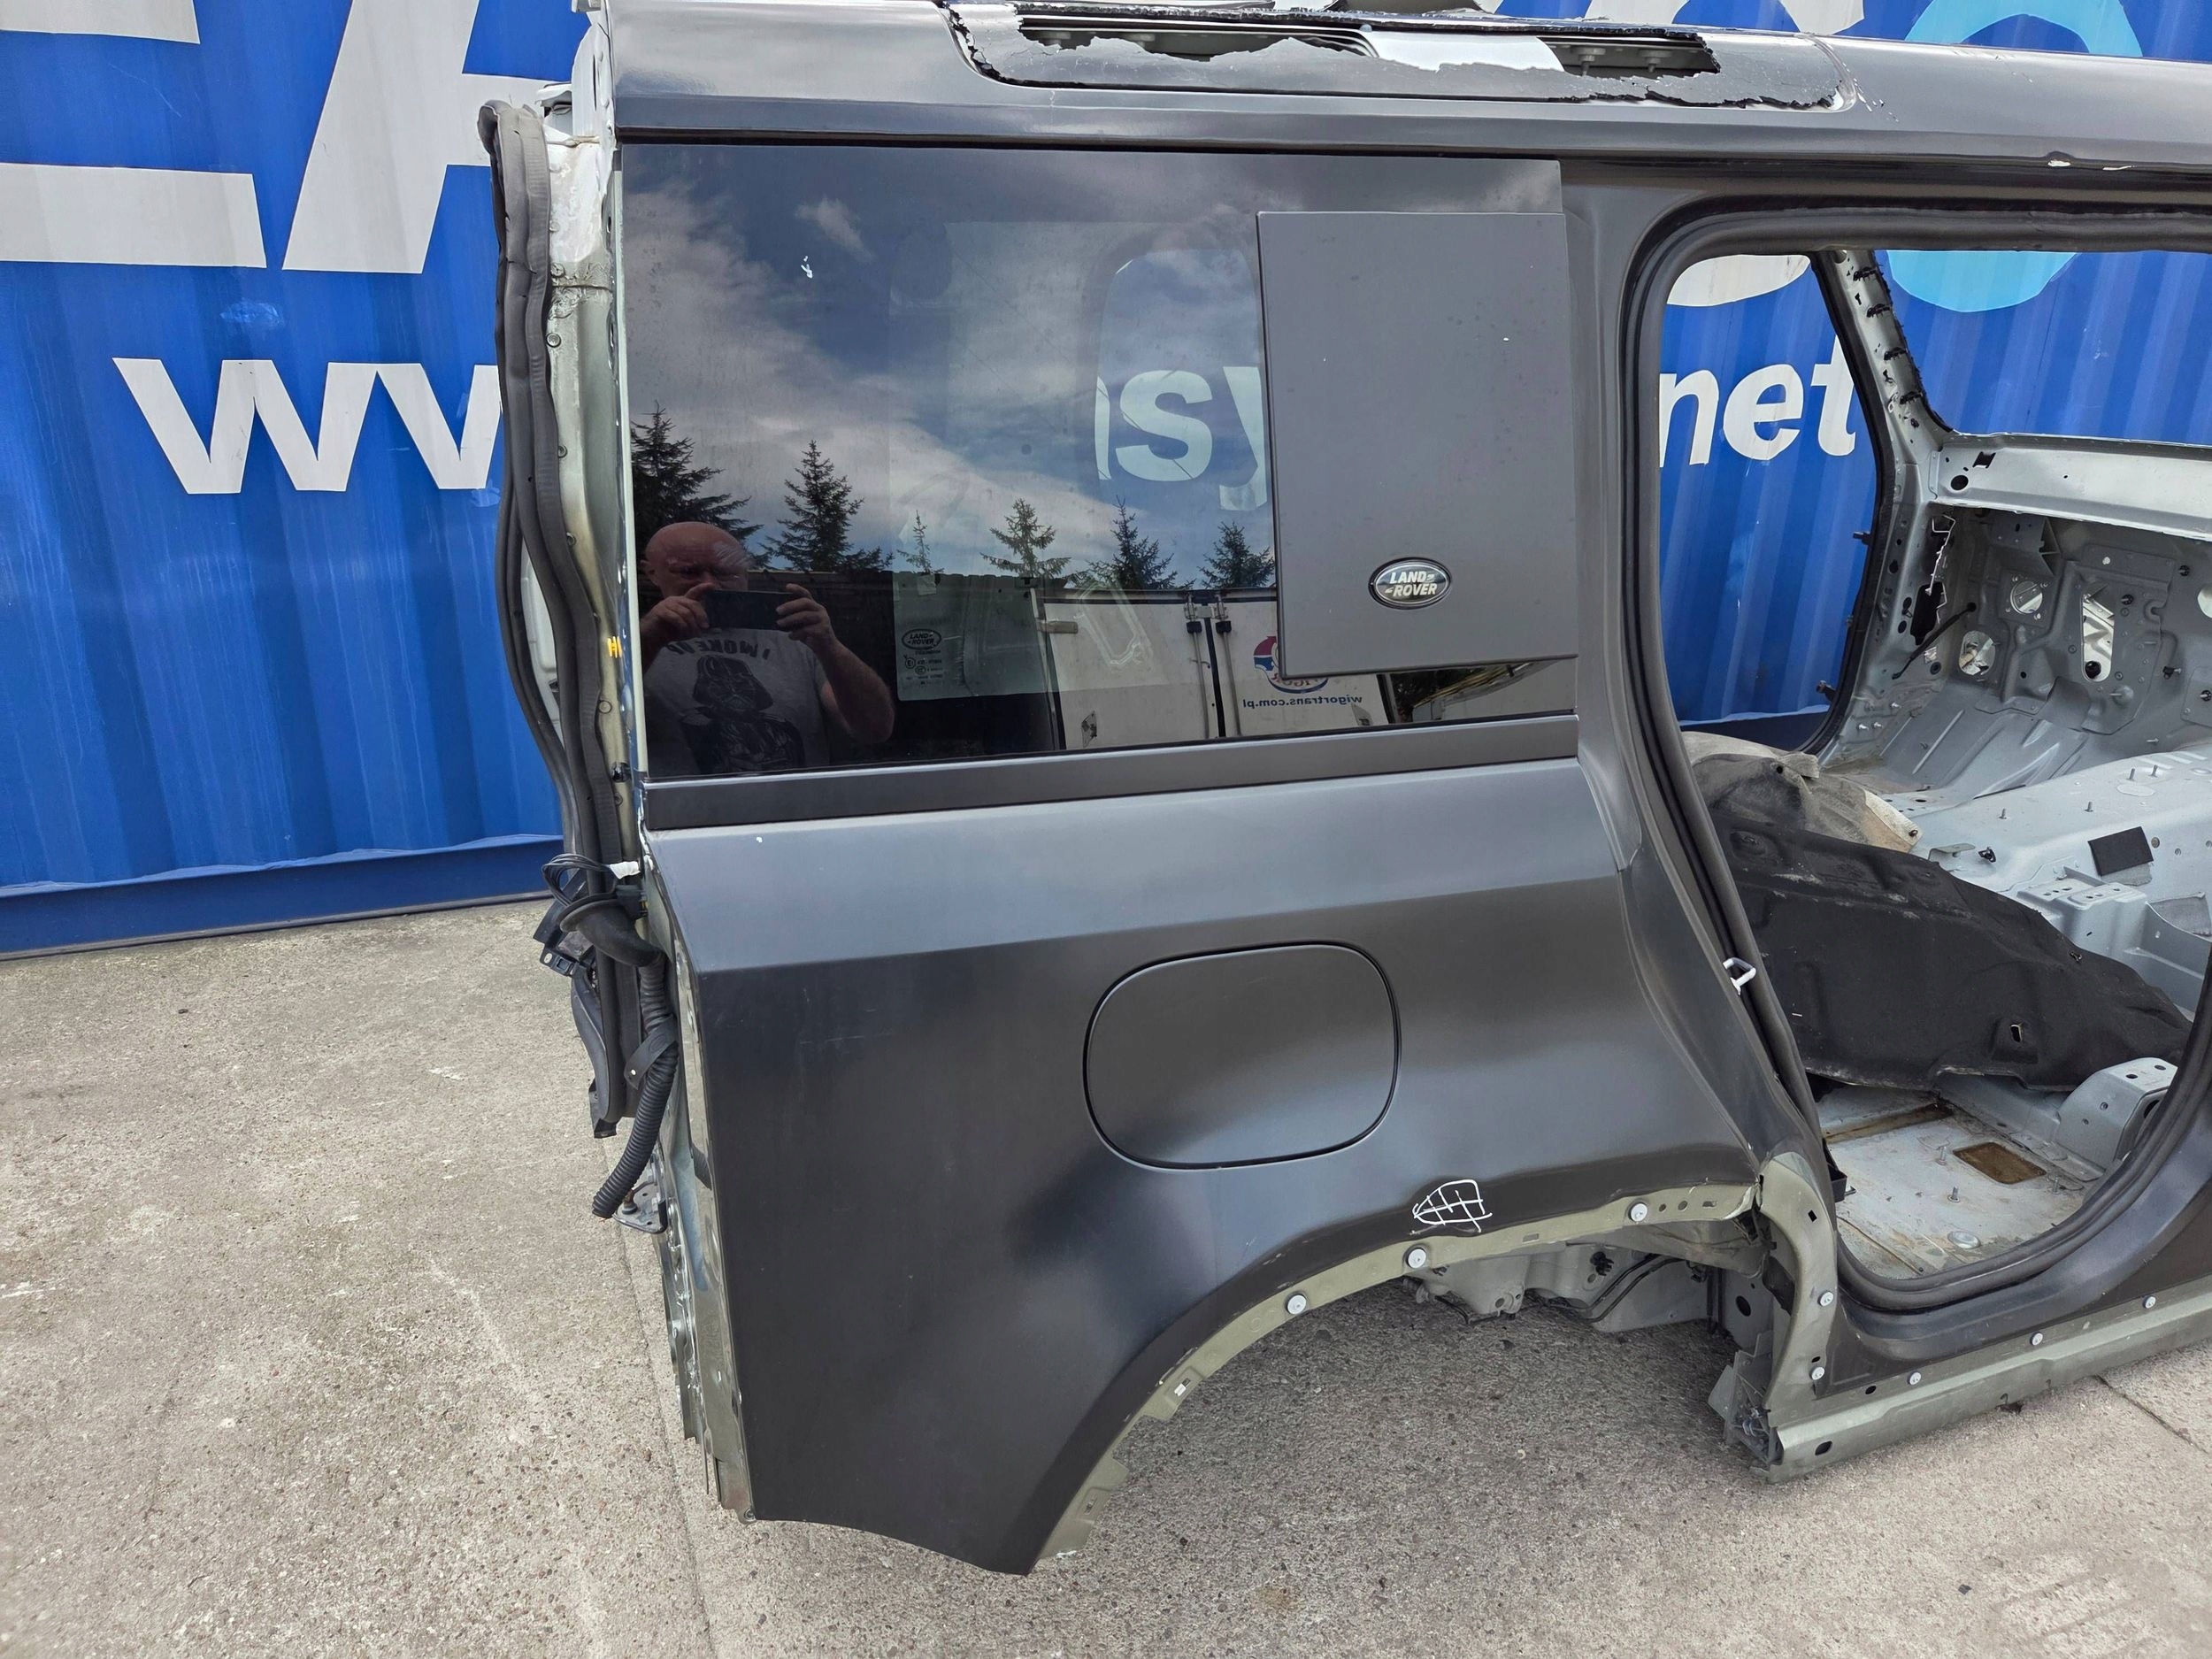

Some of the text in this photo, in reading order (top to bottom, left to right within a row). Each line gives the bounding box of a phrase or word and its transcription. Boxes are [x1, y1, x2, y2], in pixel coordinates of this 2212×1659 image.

[1659, 334, 1856, 467] net
[1389, 571, 1427, 584] LAND
[1393, 583, 1438, 597] ROVER
